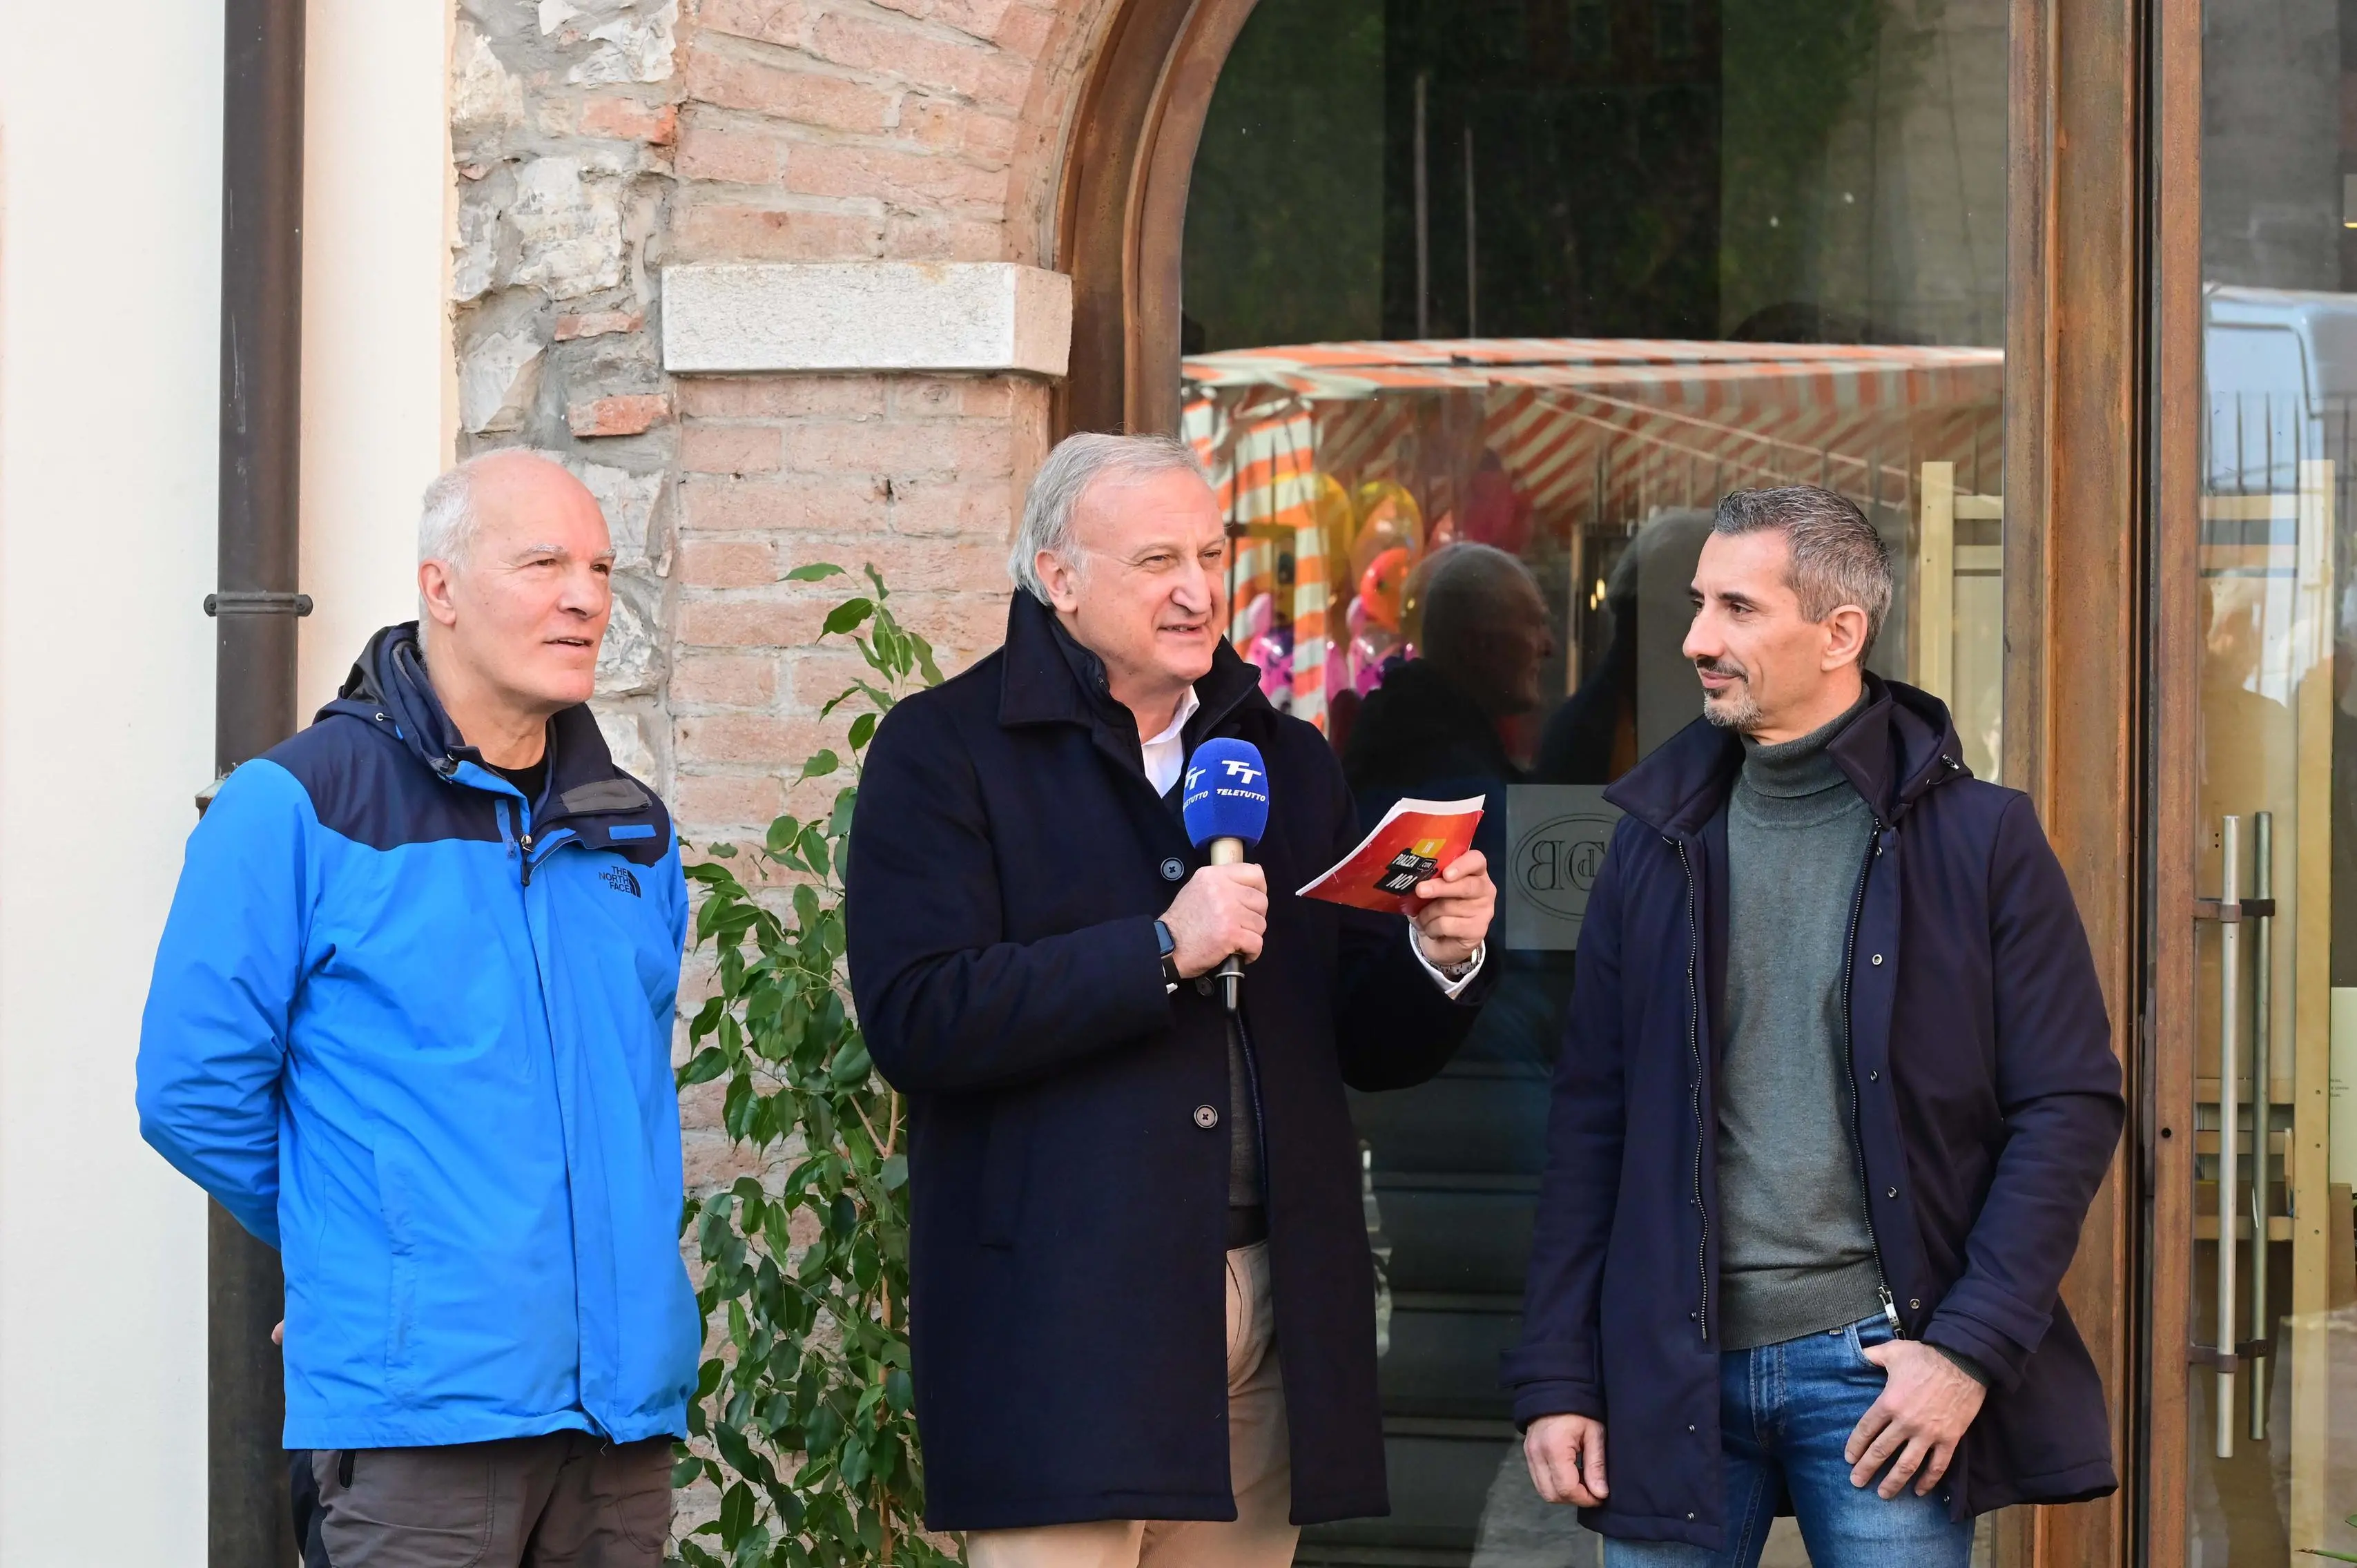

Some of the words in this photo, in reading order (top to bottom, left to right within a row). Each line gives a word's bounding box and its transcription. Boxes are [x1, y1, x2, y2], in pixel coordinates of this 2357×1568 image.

[1221, 759, 1262, 784] TT
[1216, 788, 1266, 802] TELETUTTO
[1392, 853, 1419, 868] PIAZZA
[599, 871, 629, 884] NORTH
[611, 866, 628, 876] THE
[609, 882, 630, 893] FACE
[1386, 873, 1418, 890] NOI
